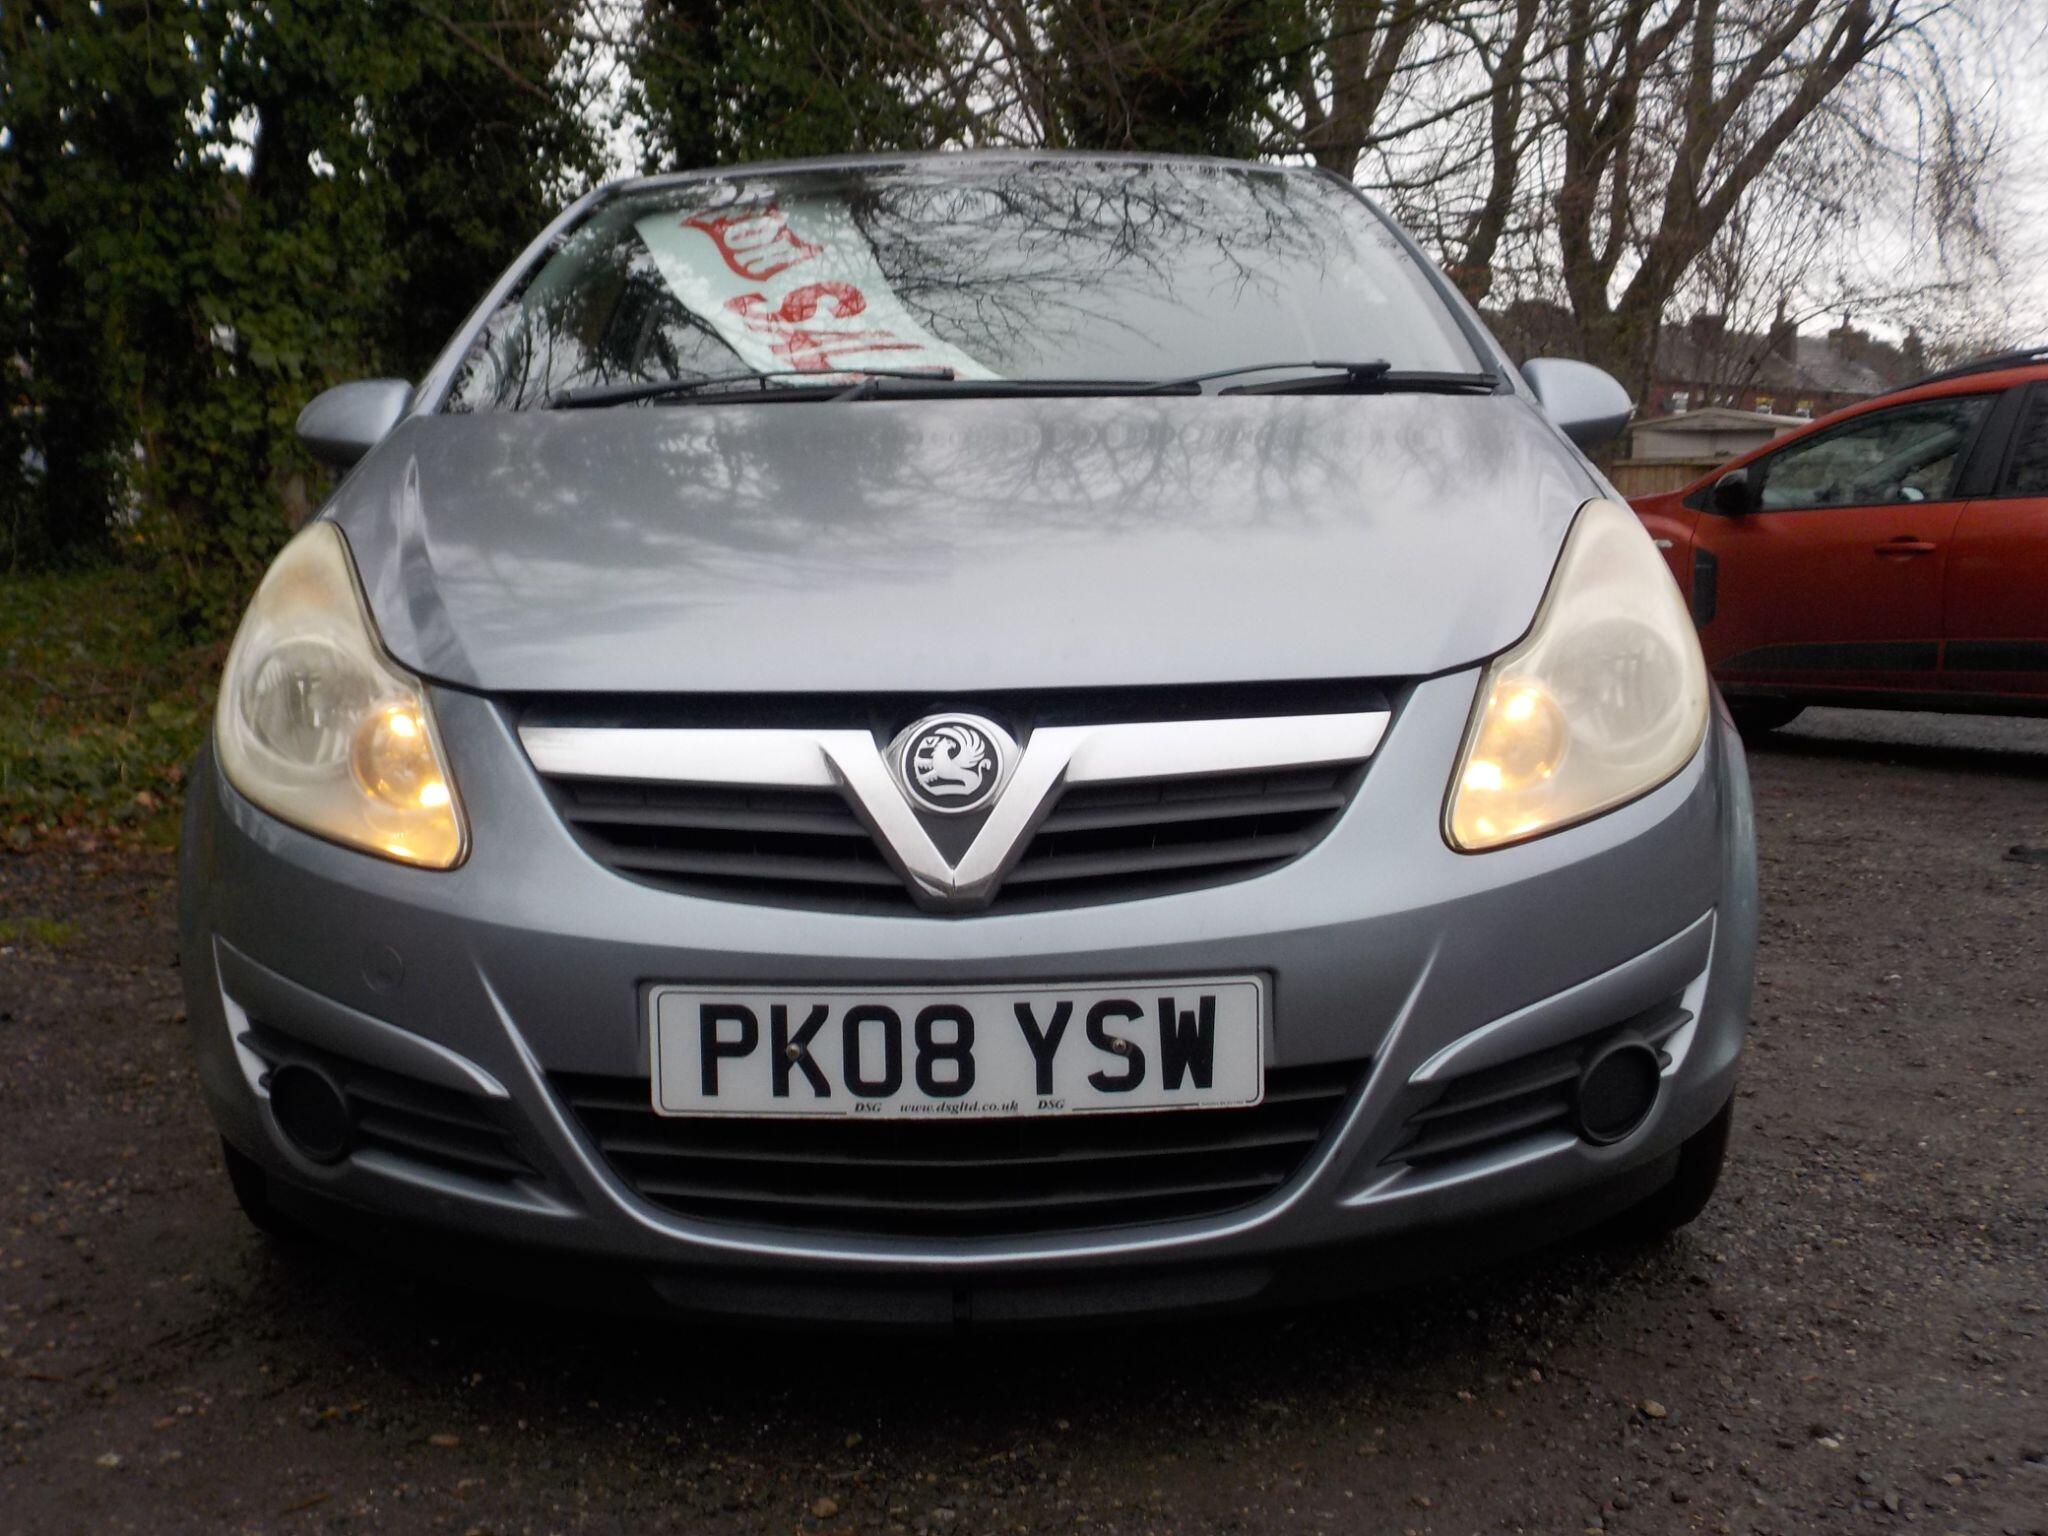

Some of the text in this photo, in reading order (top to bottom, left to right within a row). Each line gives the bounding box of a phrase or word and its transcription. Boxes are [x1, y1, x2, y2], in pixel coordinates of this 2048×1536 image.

[699, 995, 1217, 1098] PK08 YSW
[854, 1099, 1065, 1115] DSG www.dsgltd.co.uk DSG
